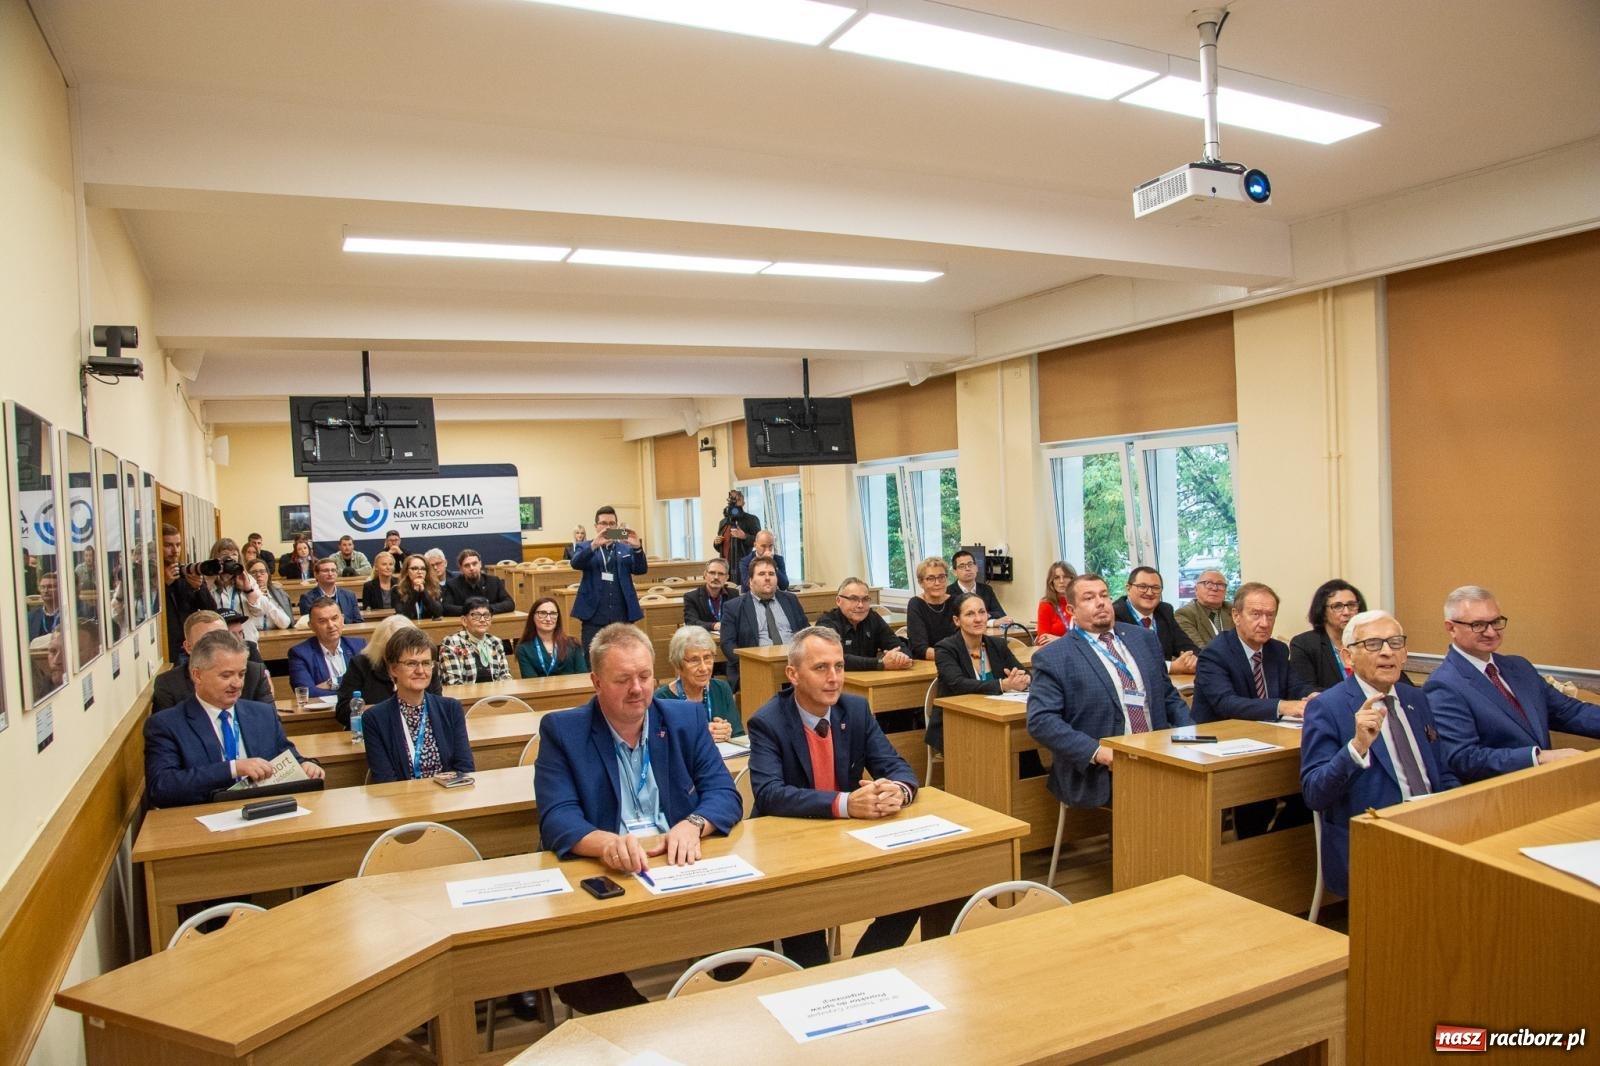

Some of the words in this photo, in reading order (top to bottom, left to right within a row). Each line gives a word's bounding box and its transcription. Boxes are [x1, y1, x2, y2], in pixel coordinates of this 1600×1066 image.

[394, 493, 483, 509] AKADEMIA
[393, 510, 418, 519] NAUK
[419, 508, 484, 518] STOSOWANYCH
[411, 523, 420, 531] W
[421, 521, 469, 531] RACIBORZU
